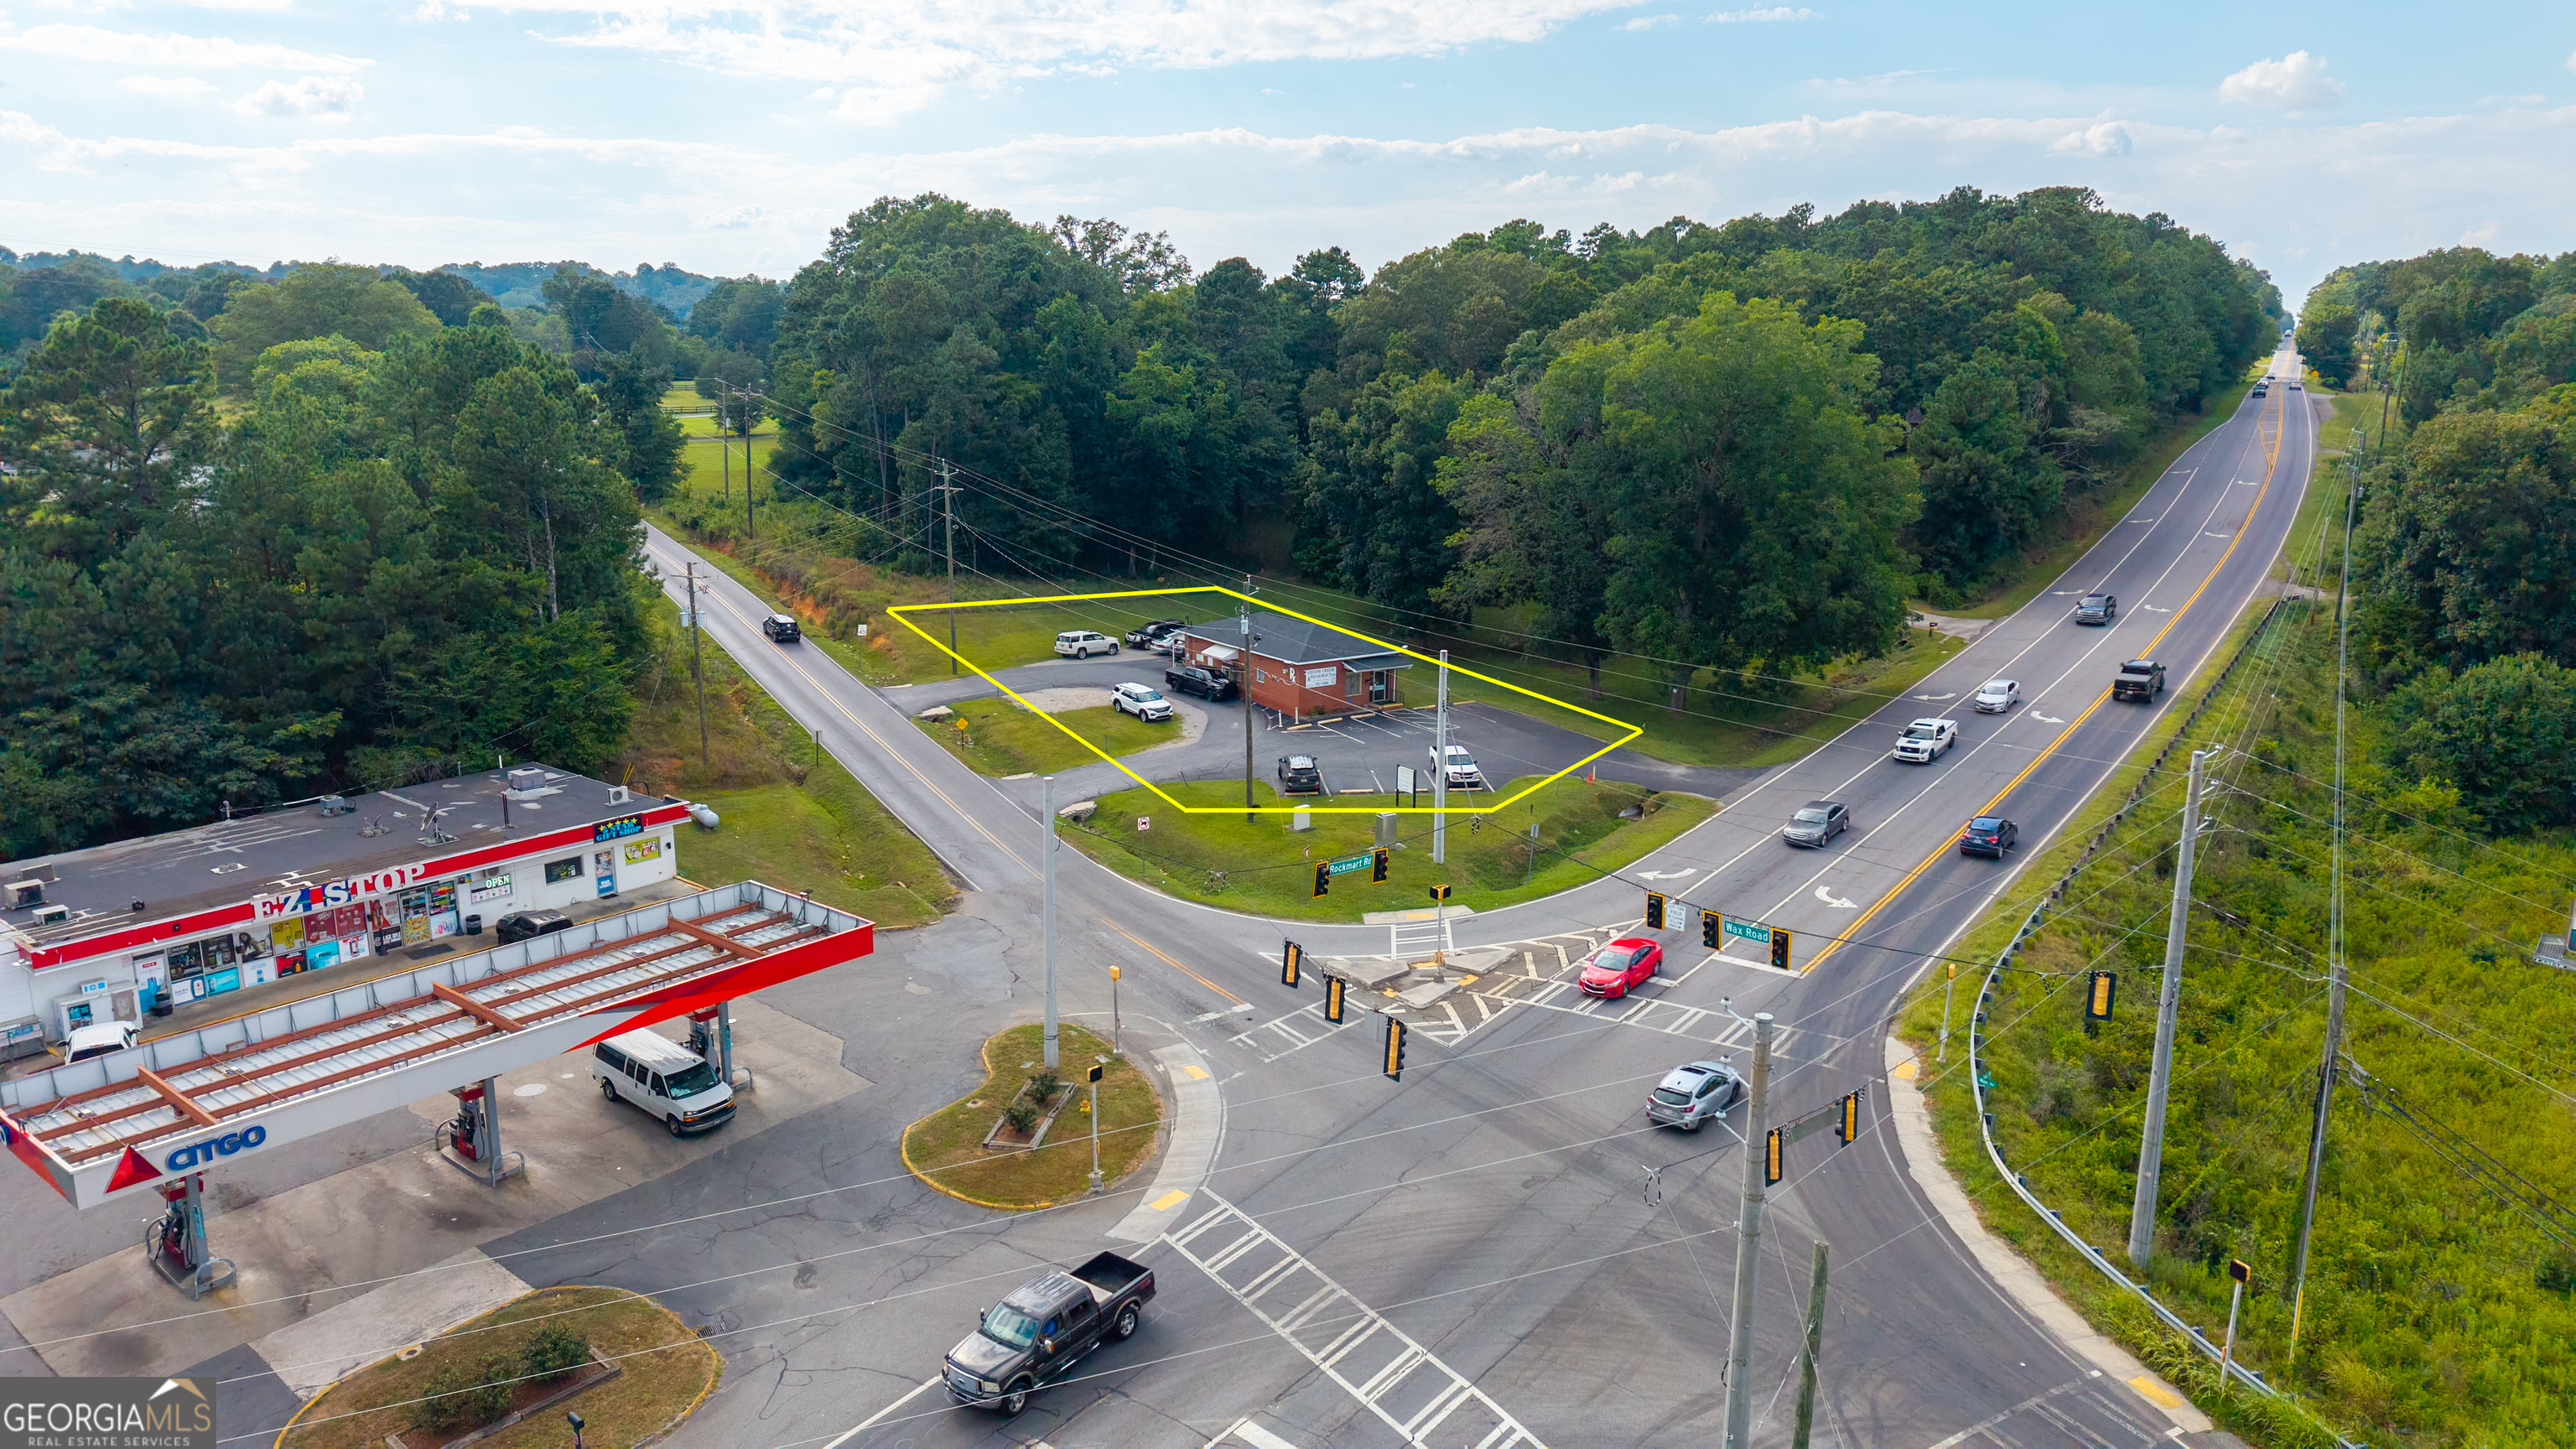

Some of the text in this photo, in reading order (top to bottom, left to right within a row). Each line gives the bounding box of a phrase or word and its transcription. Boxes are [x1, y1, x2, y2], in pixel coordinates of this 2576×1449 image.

[596, 825, 641, 842] GIFT SHOP
[610, 821, 634, 831] STAR
[1330, 857, 1371, 873] Rockmart Rd
[486, 875, 510, 888] OPEN
[251, 863, 425, 922] EZ STOP
[1726, 922, 1768, 941] Wax Road
[168, 1125, 266, 1171] CITGO
